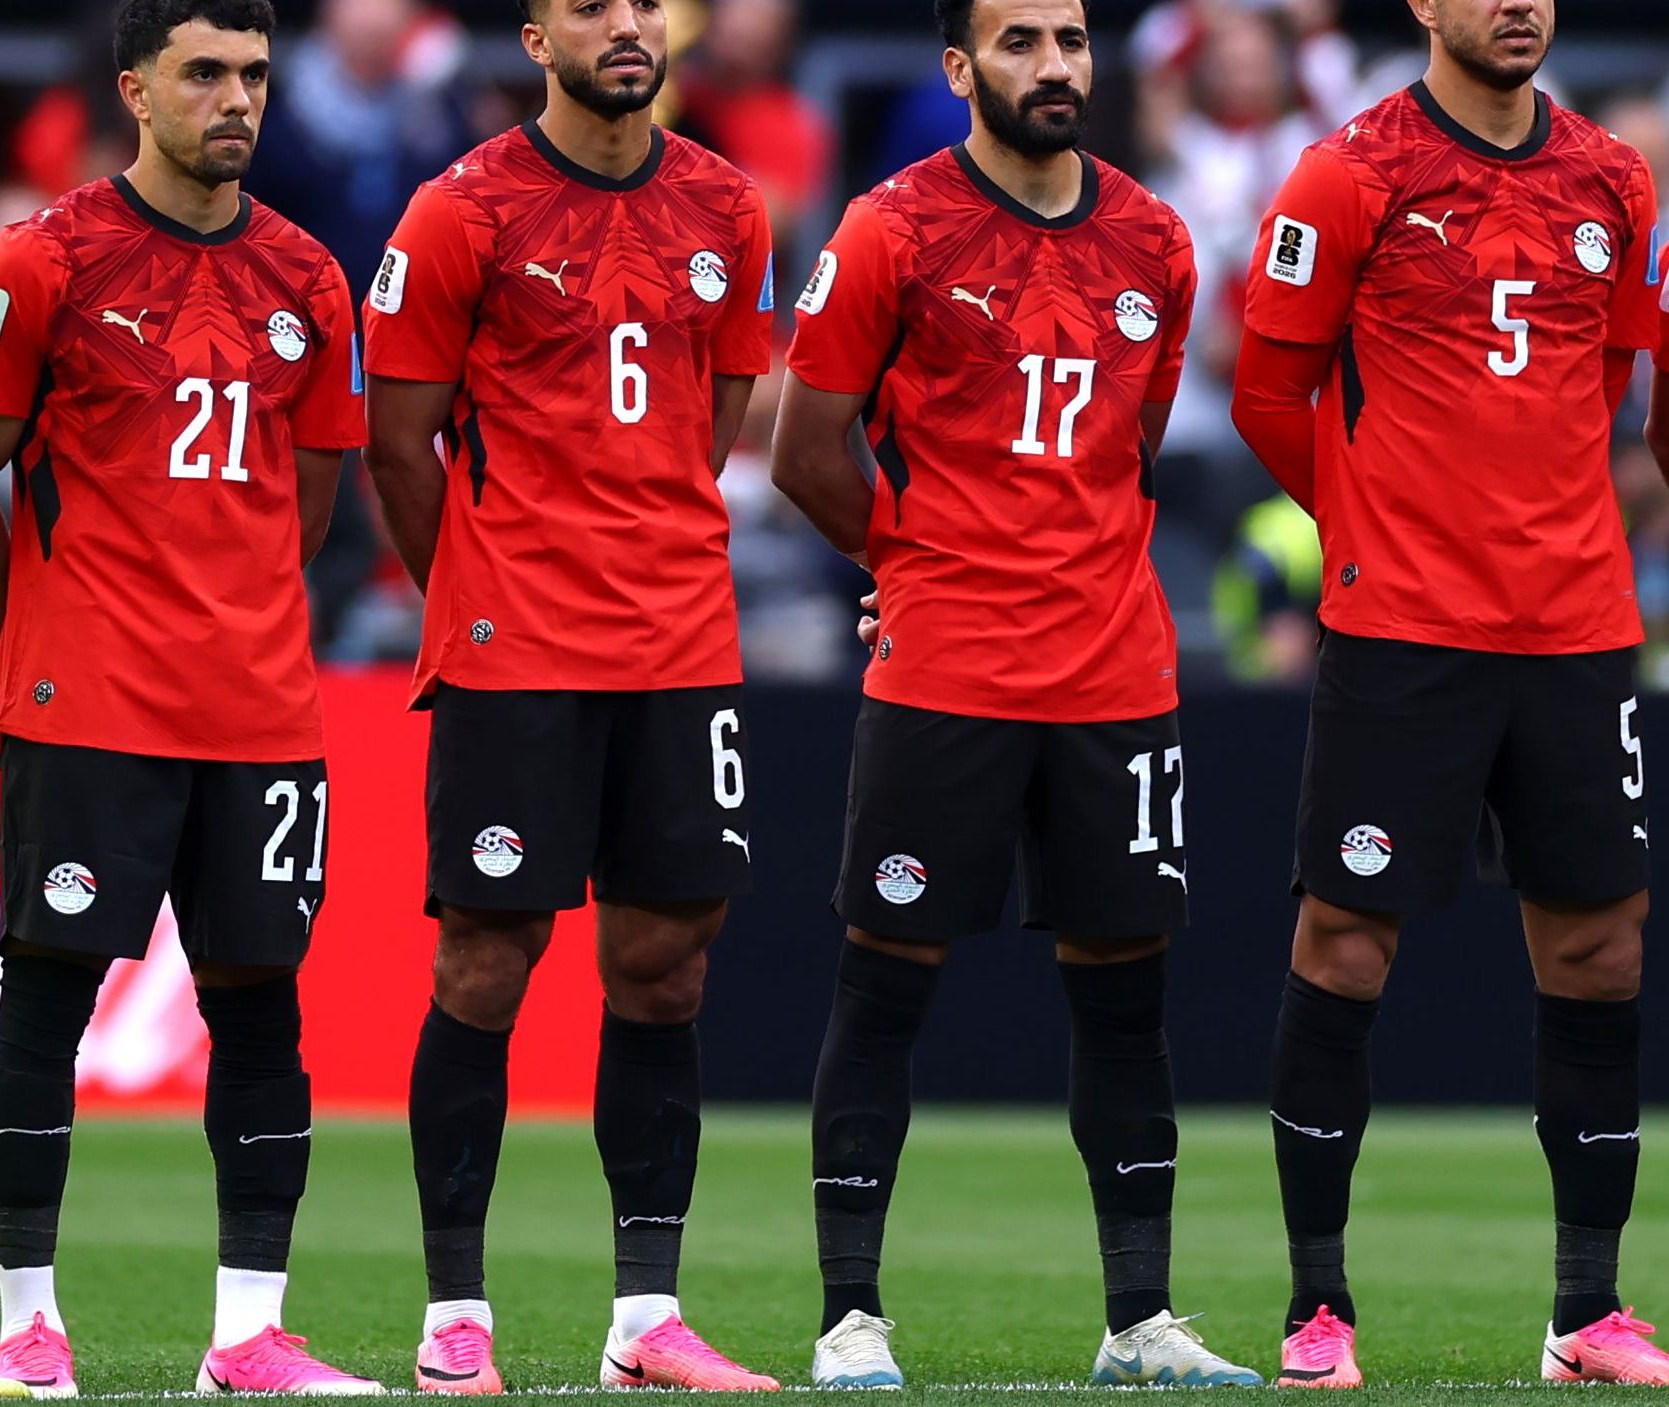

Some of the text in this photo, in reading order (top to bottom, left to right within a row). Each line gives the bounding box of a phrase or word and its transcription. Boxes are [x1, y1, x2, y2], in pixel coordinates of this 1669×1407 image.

[1273, 268, 1296, 279] 2026
[609, 322, 648, 424] 6
[1487, 279, 1537, 376] 5
[169, 377, 251, 482] 21
[1011, 354, 1098, 458] 17
[710, 708, 745, 809] 6
[1619, 695, 1644, 800] 5
[261, 780, 327, 882] 21
[1126, 745, 1184, 854] 17
